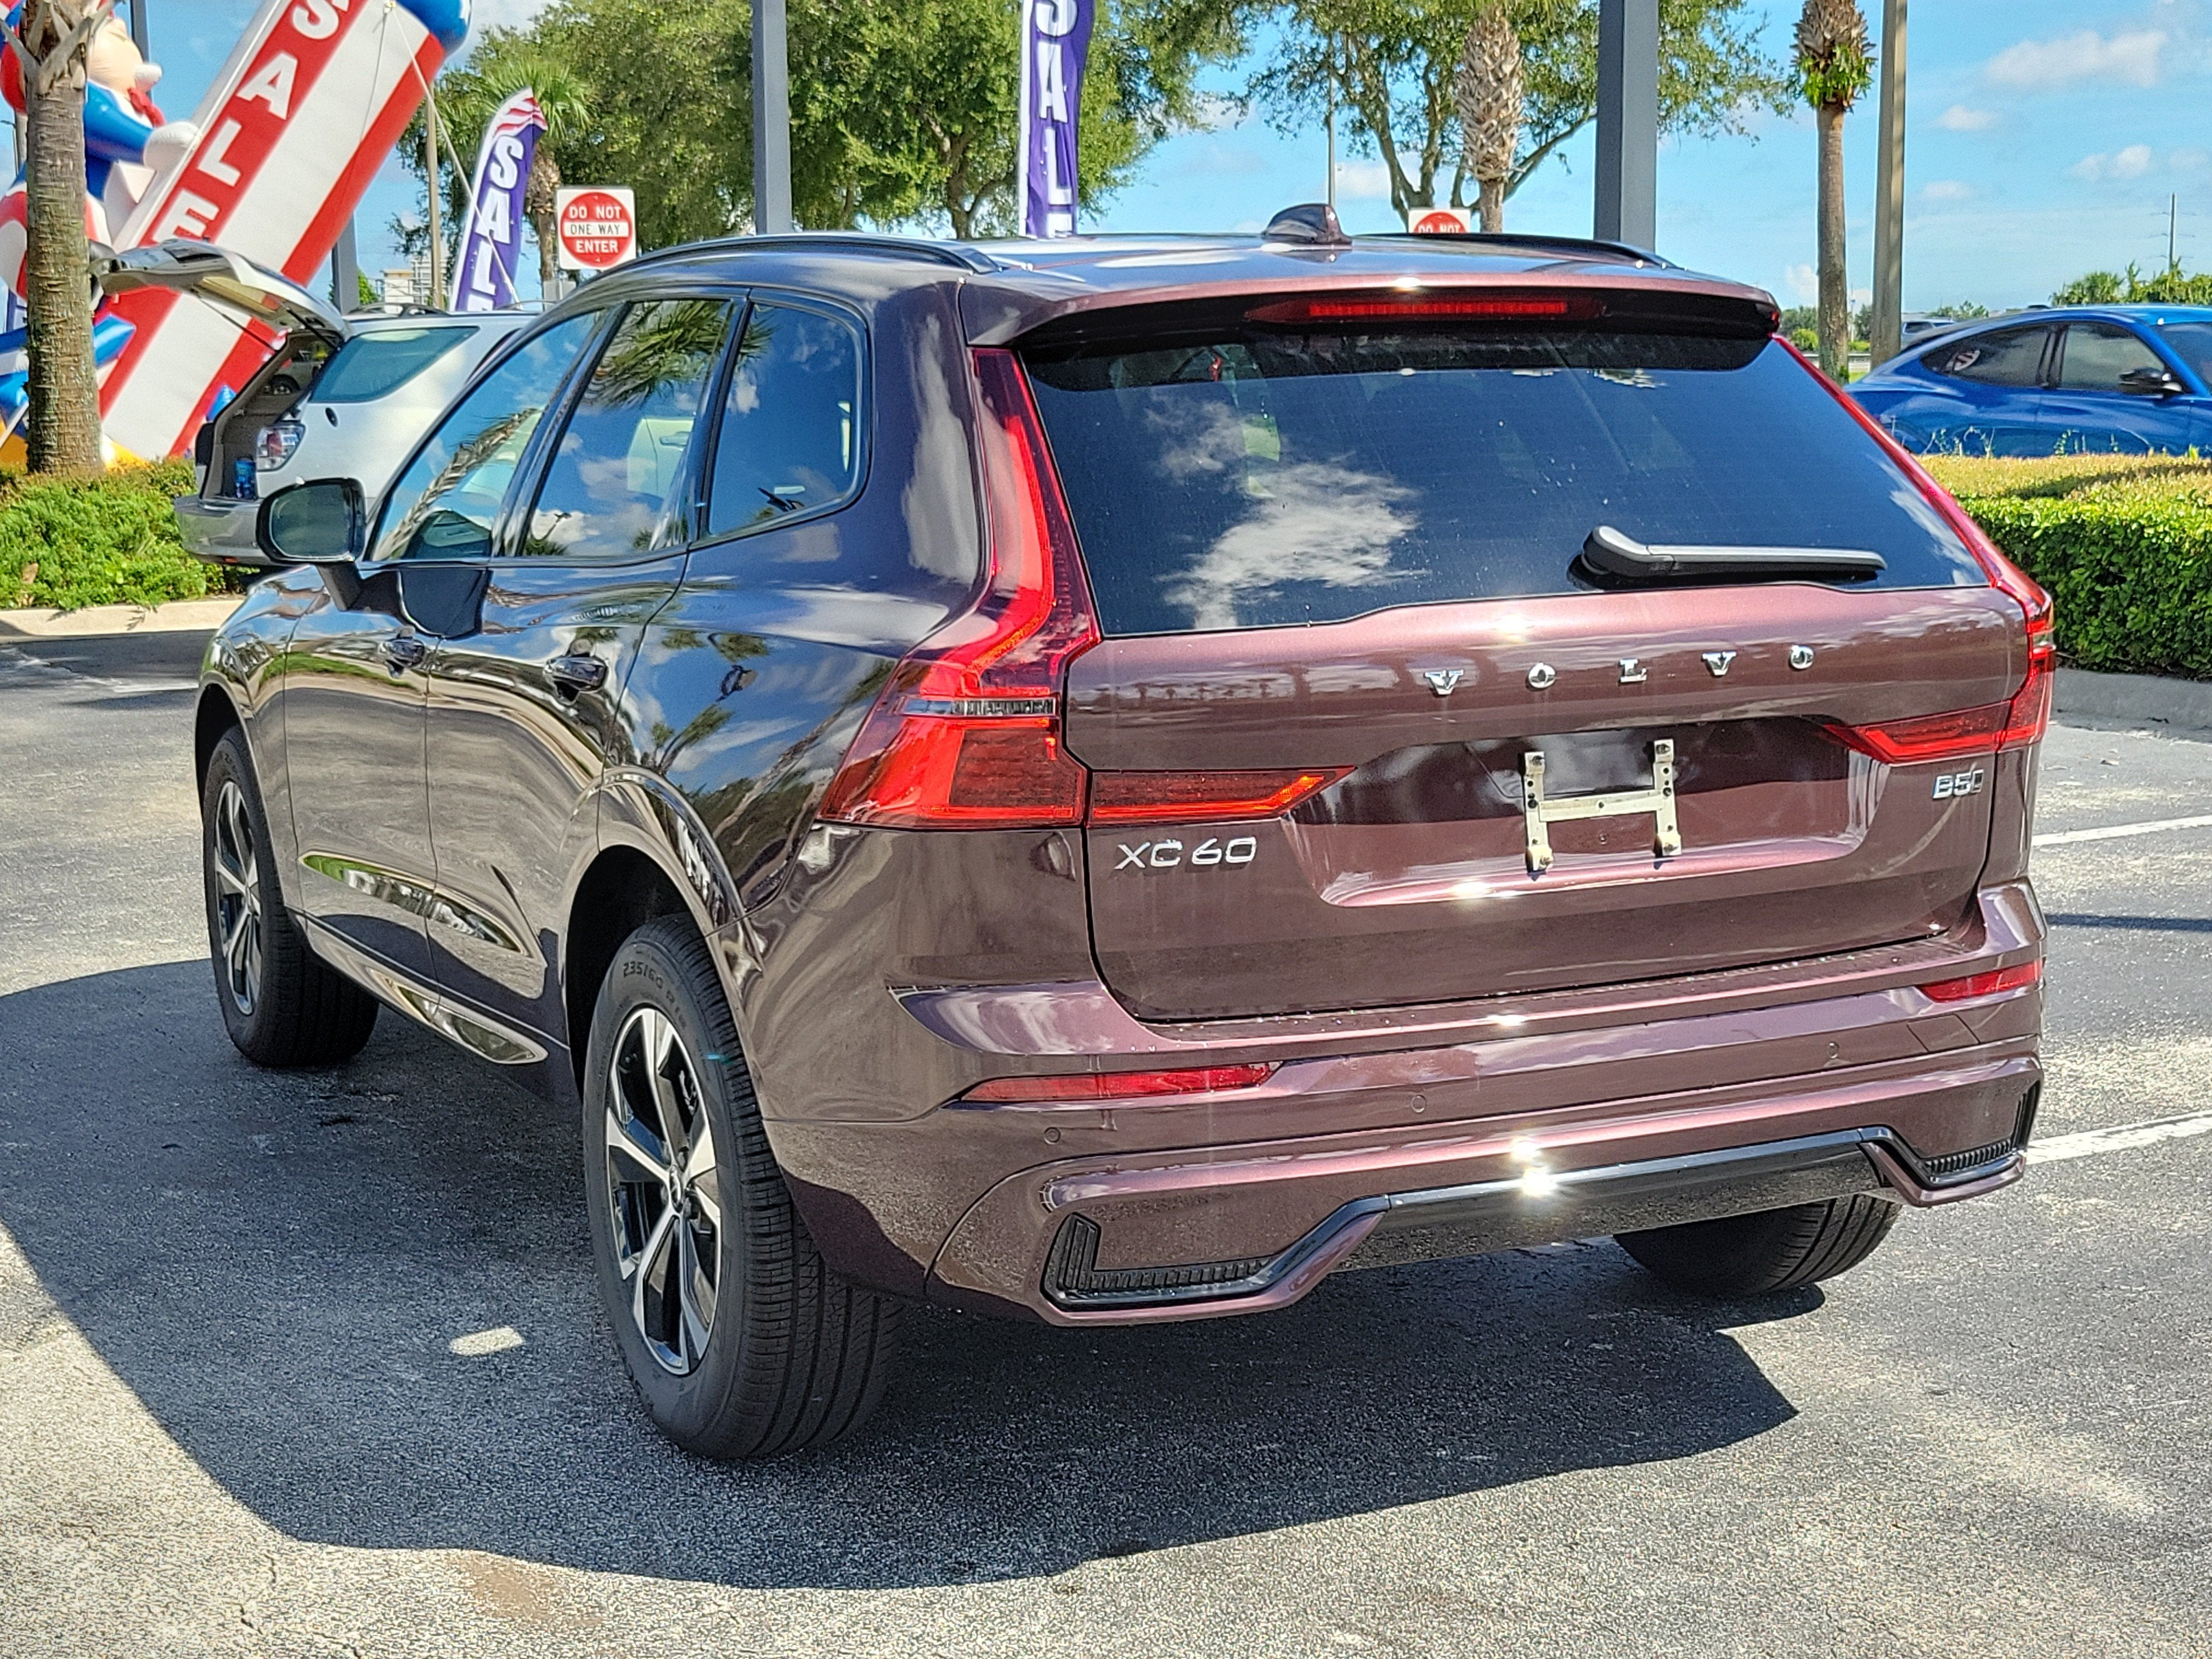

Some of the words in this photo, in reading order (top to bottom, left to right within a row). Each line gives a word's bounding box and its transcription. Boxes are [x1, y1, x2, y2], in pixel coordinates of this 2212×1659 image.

[151, 0, 349, 244] SALE
[569, 205, 588, 219] DO
[595, 205, 622, 219] NOT
[570, 224, 592, 235] ONE
[598, 224, 620, 235] WAY
[1418, 224, 1433, 233] DO
[1440, 224, 1462, 233] NOT
[576, 239, 619, 253] ENTER
[1425, 644, 1815, 696] VOLVO
